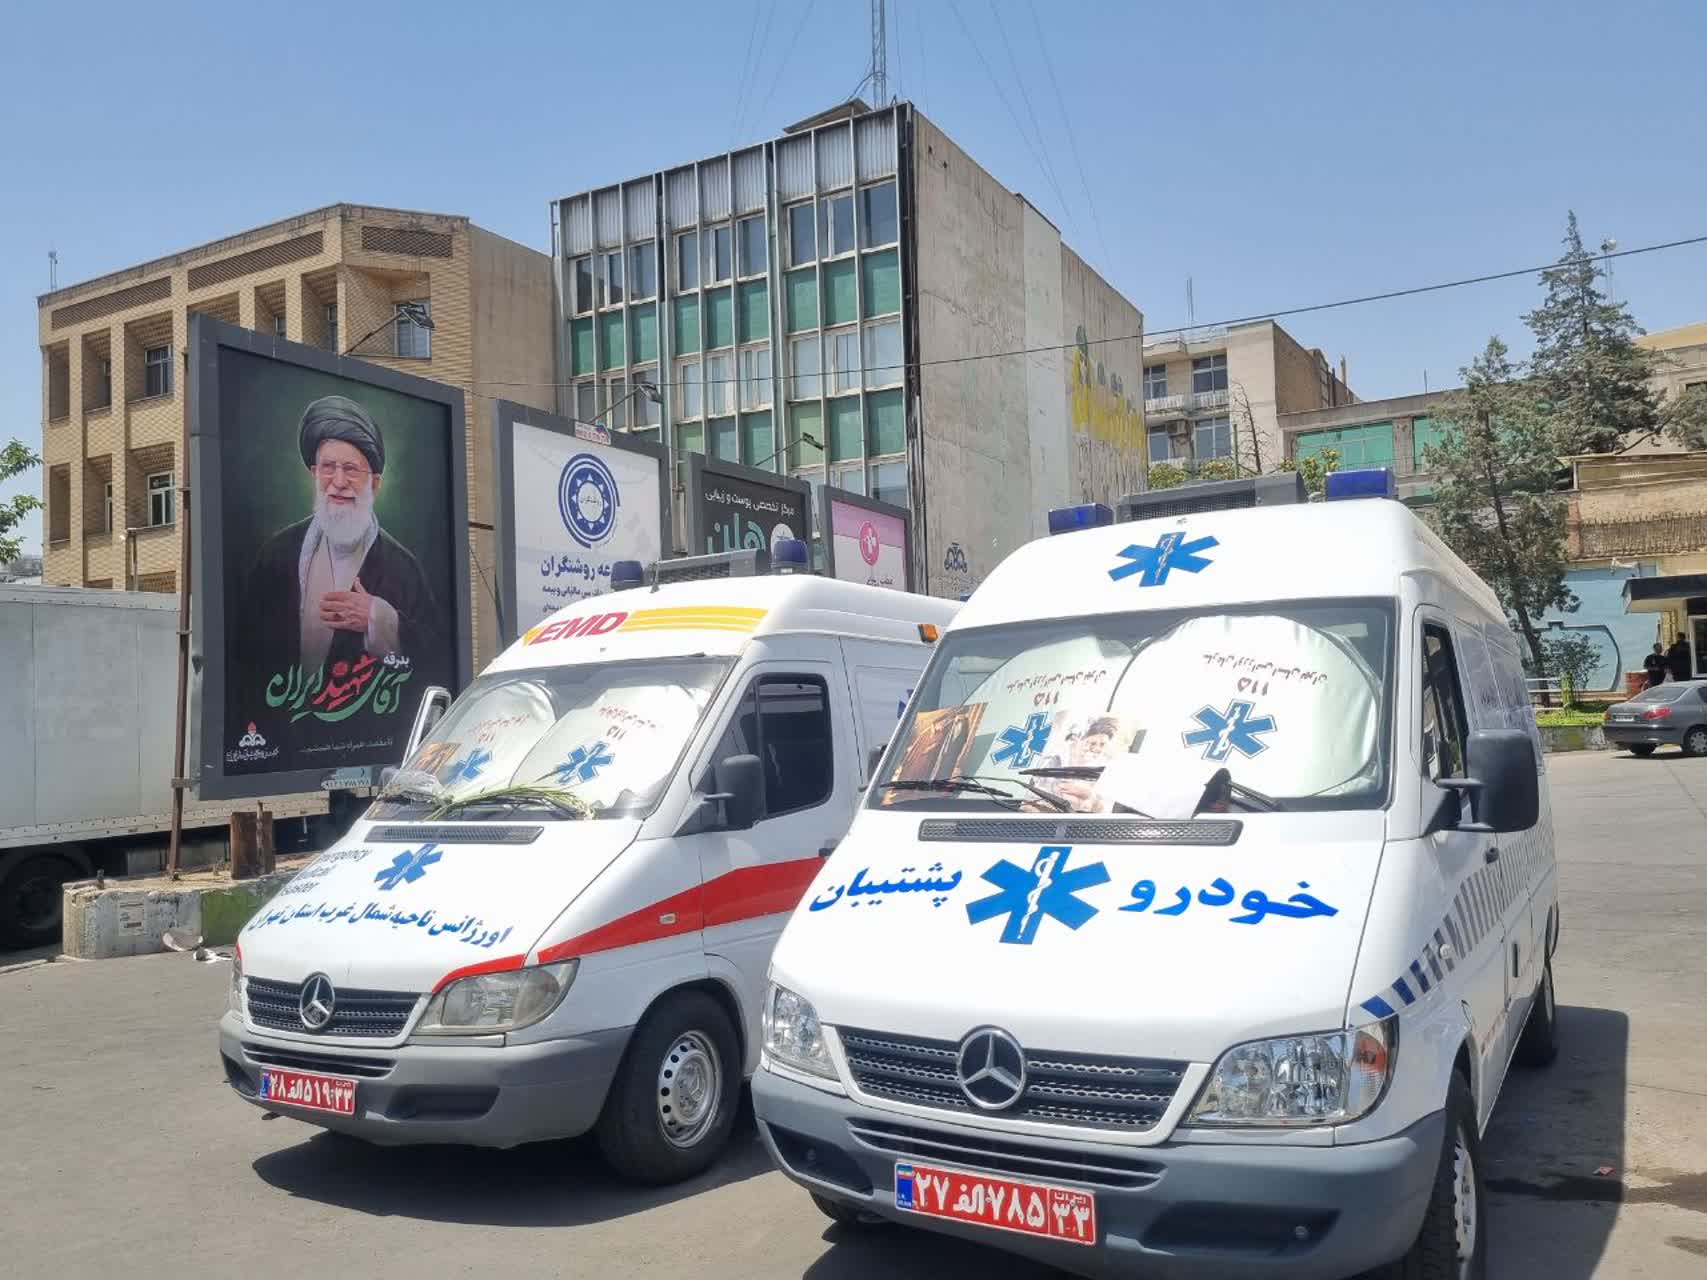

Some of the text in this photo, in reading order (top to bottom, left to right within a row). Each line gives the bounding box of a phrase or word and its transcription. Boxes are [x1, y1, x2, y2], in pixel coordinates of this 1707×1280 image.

[705, 488, 725, 503] زیبایی
[732, 494, 752, 509] پوست
[753, 501, 779, 511] تخصصی
[541, 555, 596, 581] روشنگران
[528, 611, 628, 646] EMD
[383, 652, 410, 669] بدرقه
[266, 663, 325, 714] ایران
[312, 654, 378, 711] شهید
[1237, 677, 1269, 696] ۱۱۵
[809, 867, 1339, 925] خودرو پشتیبان
[279, 902, 327, 925] استان
[319, 902, 357, 924] غرب
[348, 902, 396, 924] شمال
[390, 910, 437, 929] ناحیه
[427, 914, 513, 948] اورژانس
